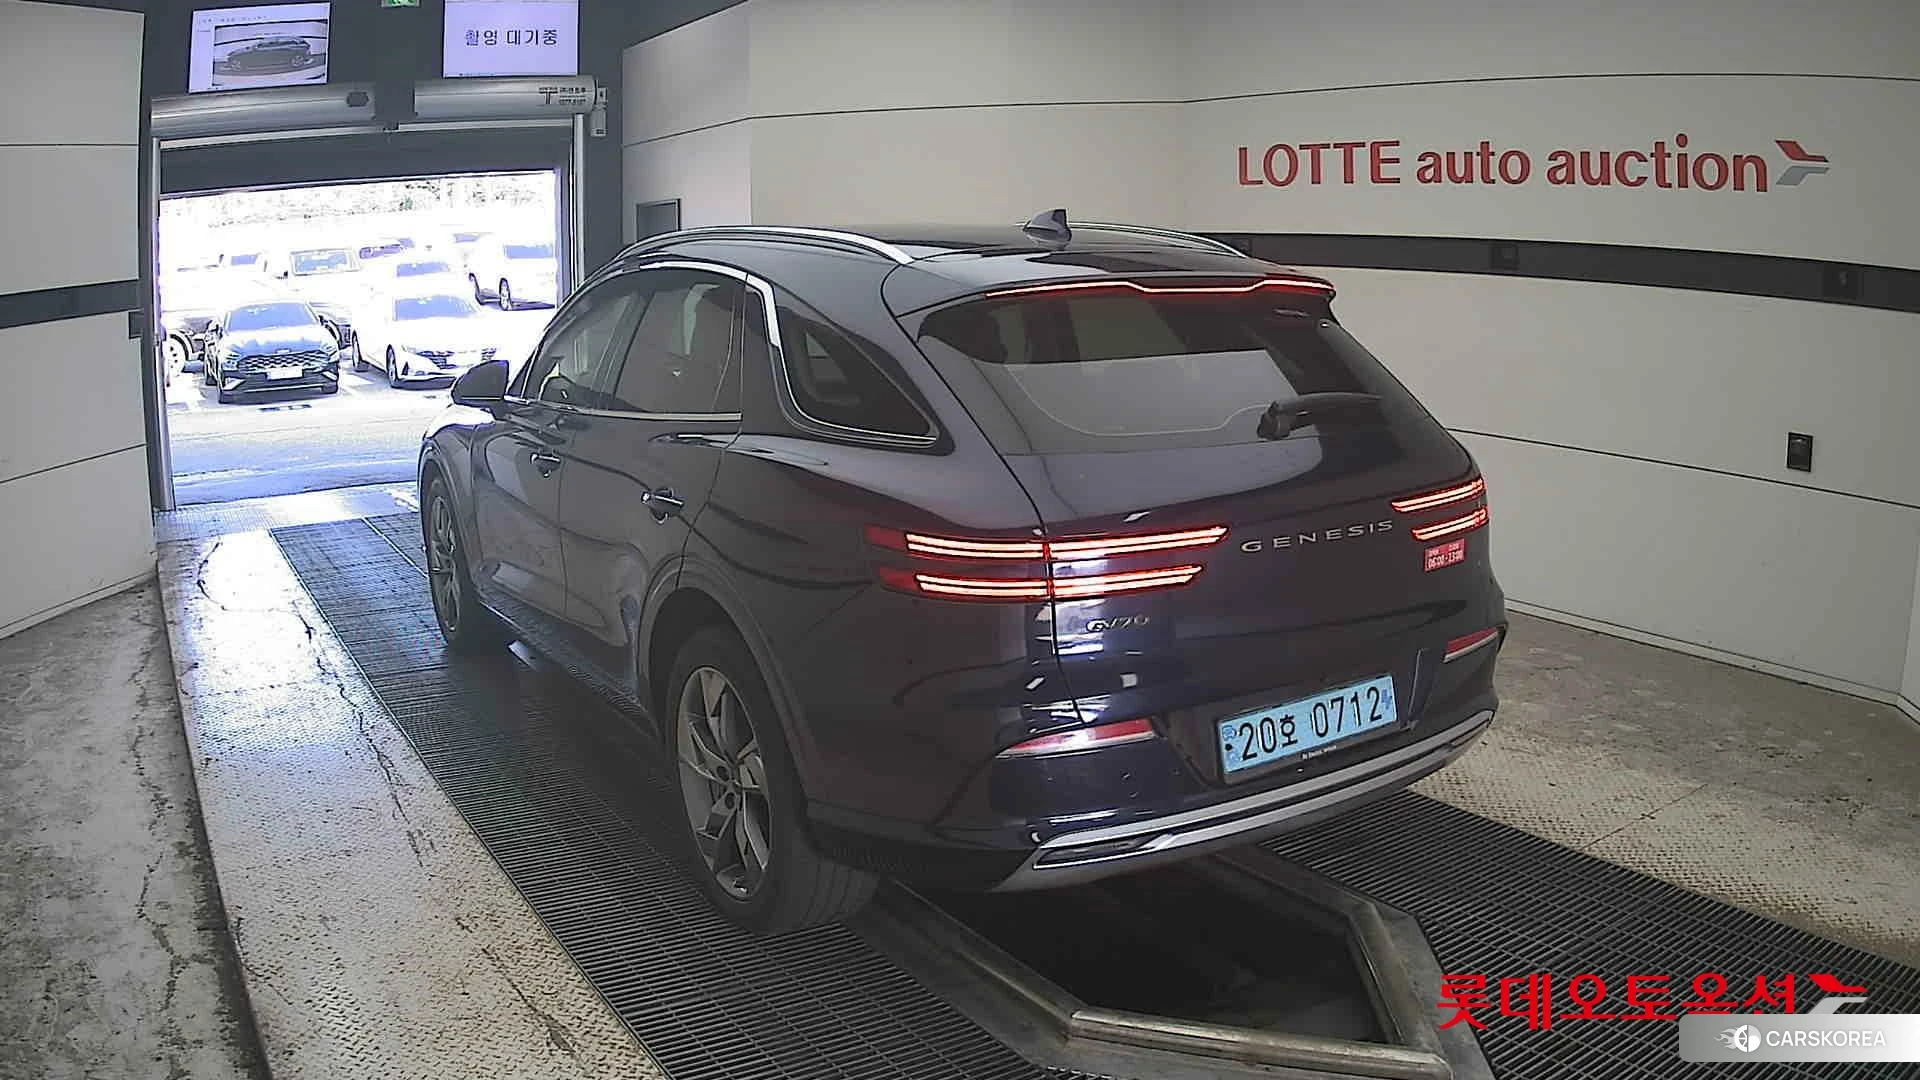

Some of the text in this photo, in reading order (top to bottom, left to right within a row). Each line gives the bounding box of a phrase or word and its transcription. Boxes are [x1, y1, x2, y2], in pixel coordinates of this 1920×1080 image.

[506, 29, 558, 46] 대기중
[1238, 133, 1768, 193] LOTTE auto auction
[1241, 520, 1393, 552] GENESIS
[1238, 686, 1382, 761] 20호 0712
